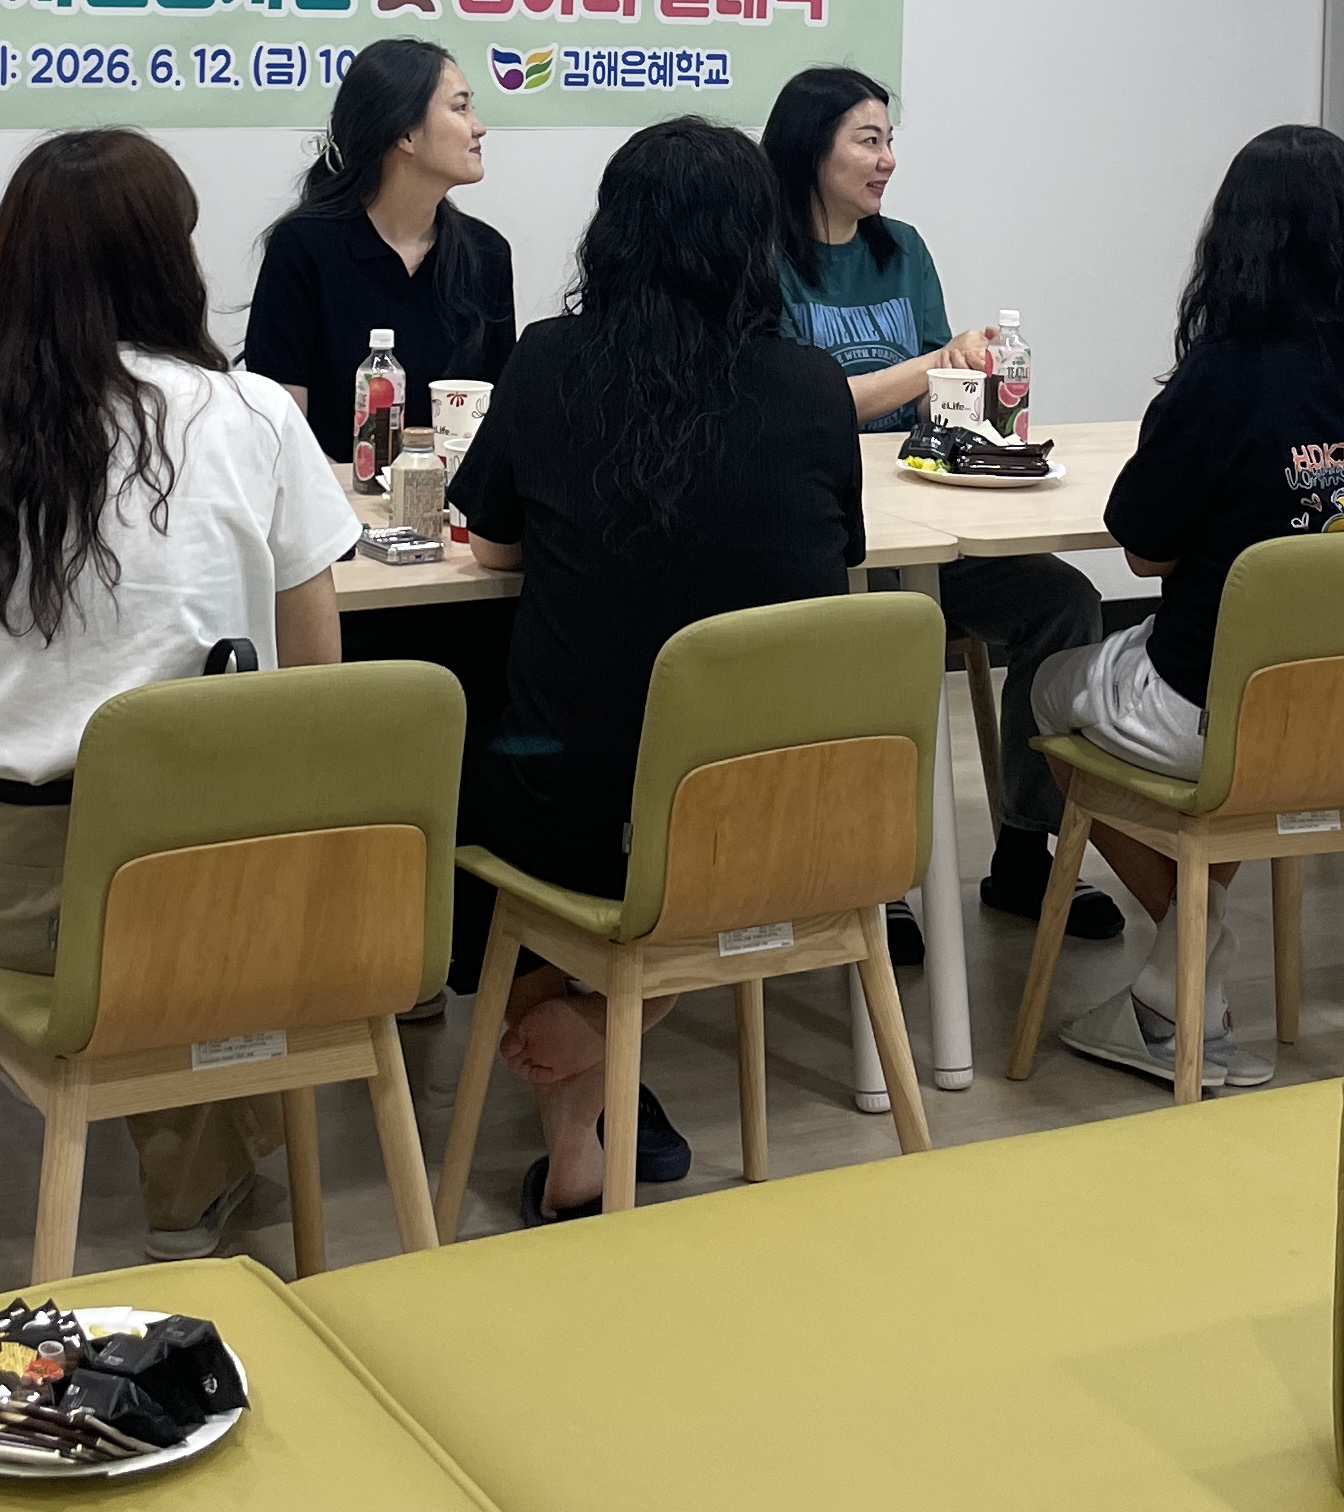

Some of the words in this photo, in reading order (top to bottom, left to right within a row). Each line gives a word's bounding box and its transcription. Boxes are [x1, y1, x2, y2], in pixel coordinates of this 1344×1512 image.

[30, 47, 138, 87] 2026.
[150, 48, 181, 87] 6.
[193, 47, 240, 87] 12.
[254, 44, 308, 88] (금)
[562, 49, 731, 88] 김해은혜학교
